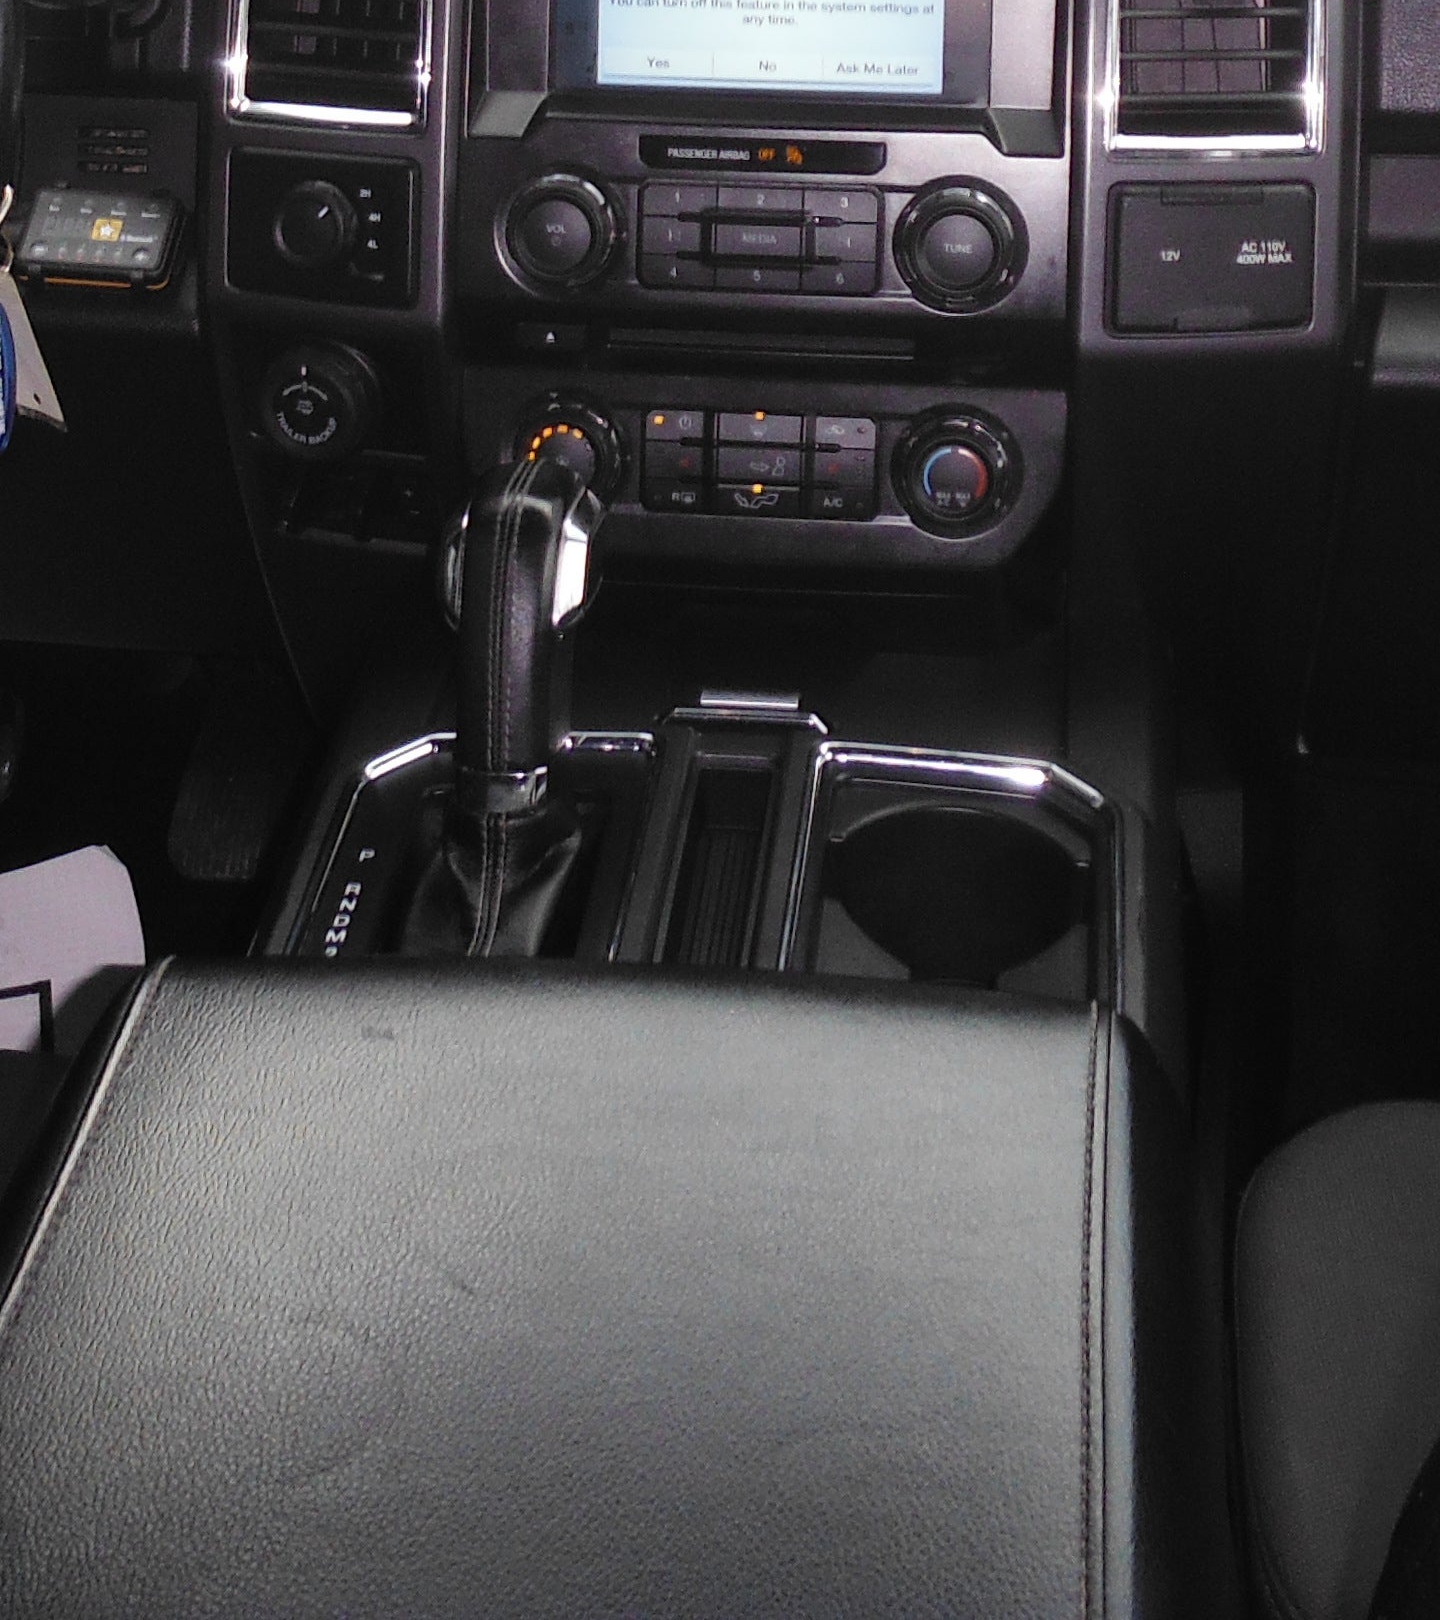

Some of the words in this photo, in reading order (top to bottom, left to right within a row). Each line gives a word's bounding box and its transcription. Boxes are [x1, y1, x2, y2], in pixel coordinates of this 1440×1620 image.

[783, 0, 795, 10] in
[798, 0, 818, 11] the
[821, 1, 866, 14] system
[742, 15, 765, 26] any
[646, 56, 670, 69] Yes
[759, 59, 777, 72] No
[836, 62, 859, 74] Ask
[863, 63, 883, 75] Me
[887, 63, 919, 76] Later
[667, 147, 717, 160] PASSENGER
[718, 149, 750, 161] AIRBAG
[840, 196, 850, 209] 3
[545, 223, 567, 235] VOL
[943, 243, 973, 254] TUNE
[1241, 241, 1258, 254] AC
[1260, 241, 1287, 254] 110V
[1161, 249, 1181, 262] 12V
[1236, 253, 1265, 265] 400W
[1267, 253, 1293, 265] MAX
[669, 266, 679, 279] 4
[276, 411, 307, 444] TRAILER
[307, 417, 338, 445] BACKUP
[823, 497, 844, 509] A/C
[359, 847, 376, 863] P
[339, 897, 357, 912] N
[333, 913, 351, 927] D
[325, 929, 347, 944] M
